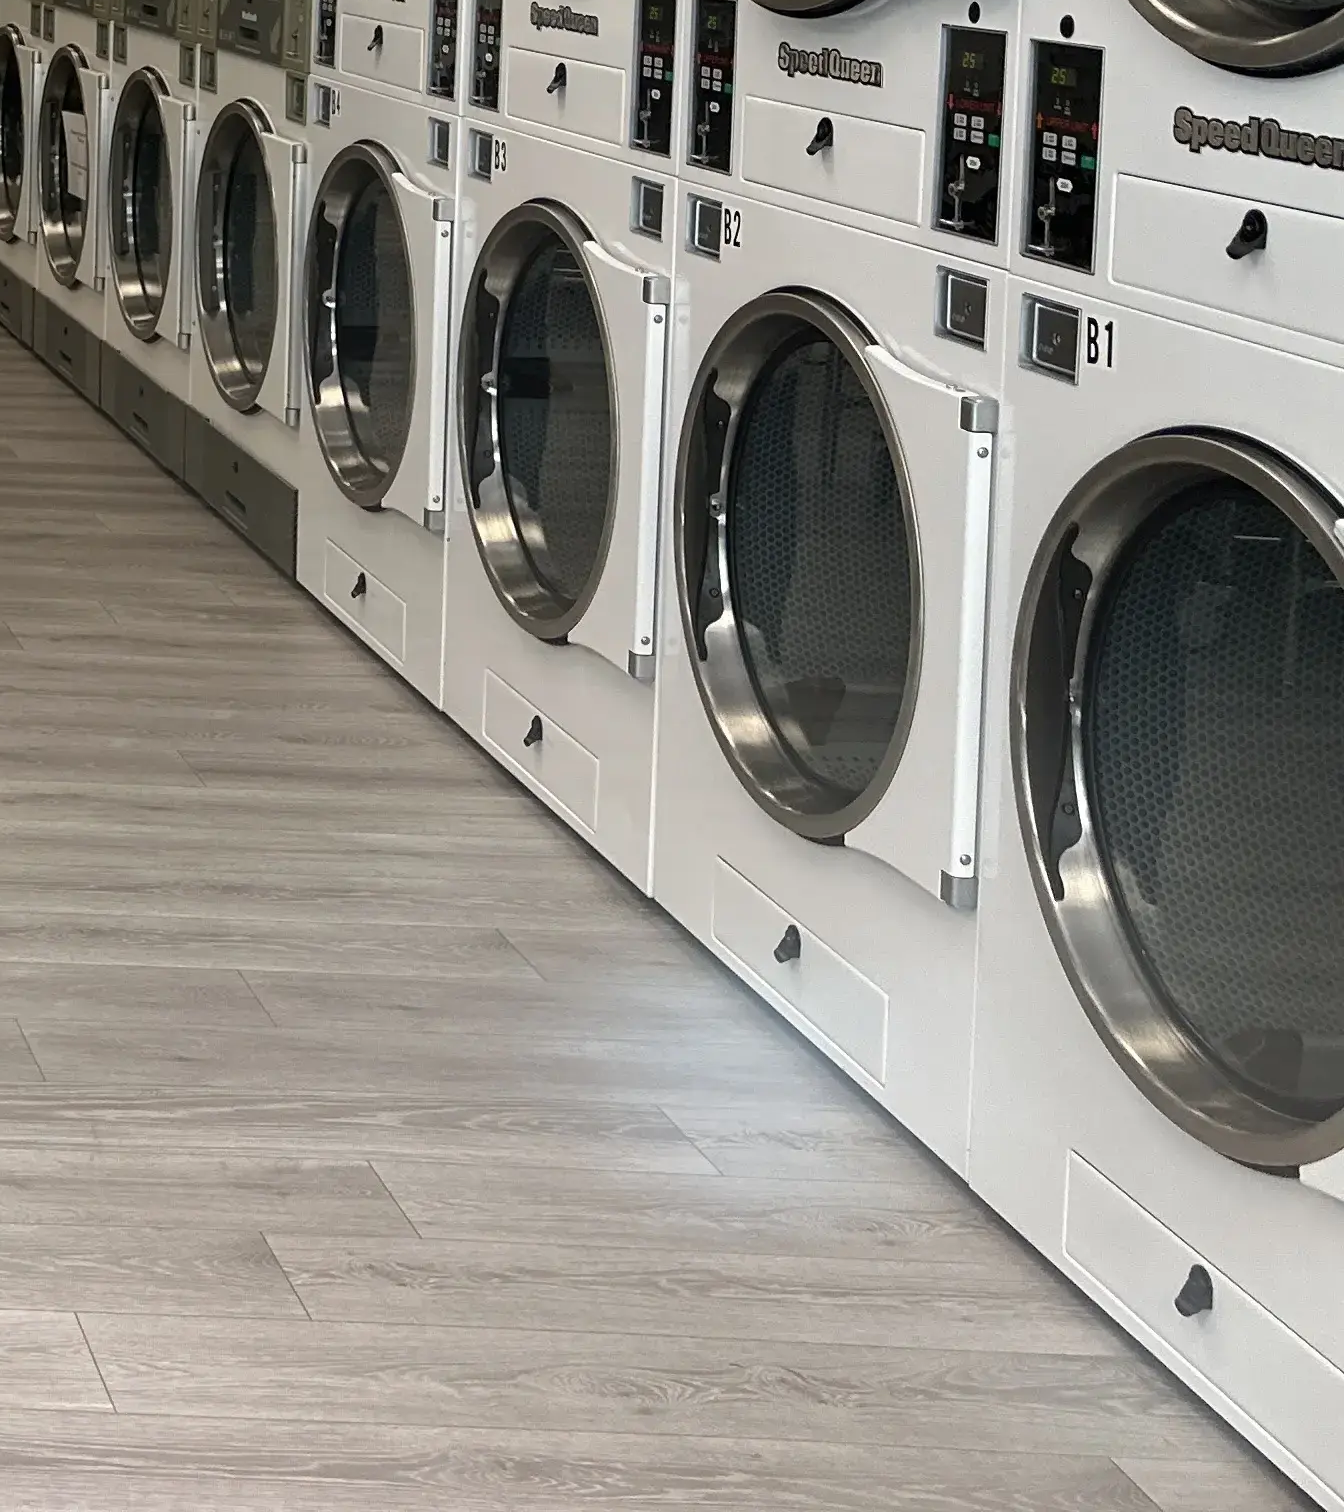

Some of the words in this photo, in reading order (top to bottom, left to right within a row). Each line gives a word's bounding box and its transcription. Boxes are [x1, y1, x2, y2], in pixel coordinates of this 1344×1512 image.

[778, 42, 829, 77] Speed
[962, 51, 976, 68] 25
[1051, 67, 1066, 85] 25
[1173, 106, 1261, 156] Speed
[495, 140, 506, 171] B3
[724, 208, 741, 247] B2
[1087, 317, 1114, 368] B1
